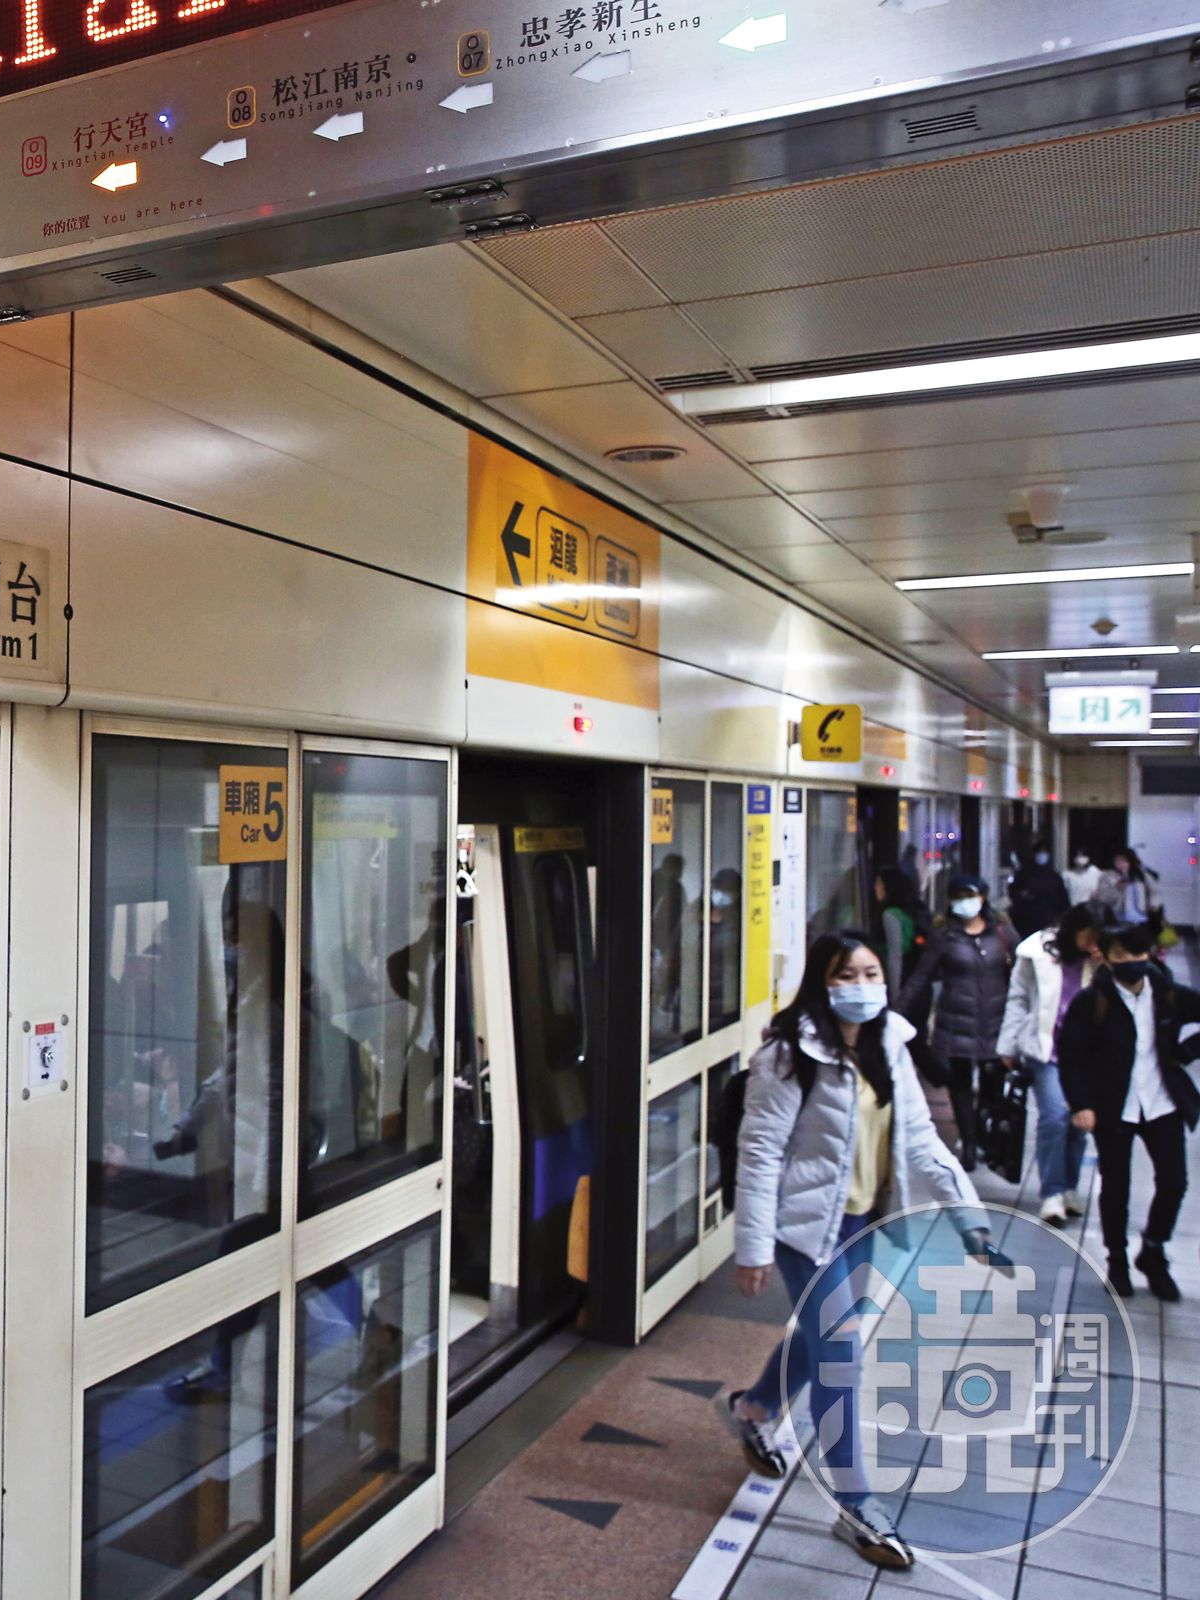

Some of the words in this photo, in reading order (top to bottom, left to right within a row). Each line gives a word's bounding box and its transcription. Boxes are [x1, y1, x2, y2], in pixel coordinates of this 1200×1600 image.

[495, 40, 594, 70] Zhongxiao
[607, 15, 701, 45] Xinsheng
[520, 0, 664, 48] 忠孝新生
[271, 53, 392, 107] 松江南京
[461, 51, 484, 71] 07
[231, 105, 252, 123] 08
[260, 98, 343, 123] Songjiang
[355, 78, 424, 103] Nanjing
[73, 111, 149, 153] 行天宮
[25, 154, 44, 171] 09
[52, 149, 115, 172] Xingtian
[125, 134, 175, 156] Temple
[42, 214, 91, 238] 你的位置
[103, 212, 130, 226] You
[136, 206, 161, 218] are
[170, 197, 203, 211] here
[28, 632, 38, 660] 1
[224, 780, 261, 817] 車廂
[263, 781, 285, 843] 5
[240, 823, 261, 843] Car
